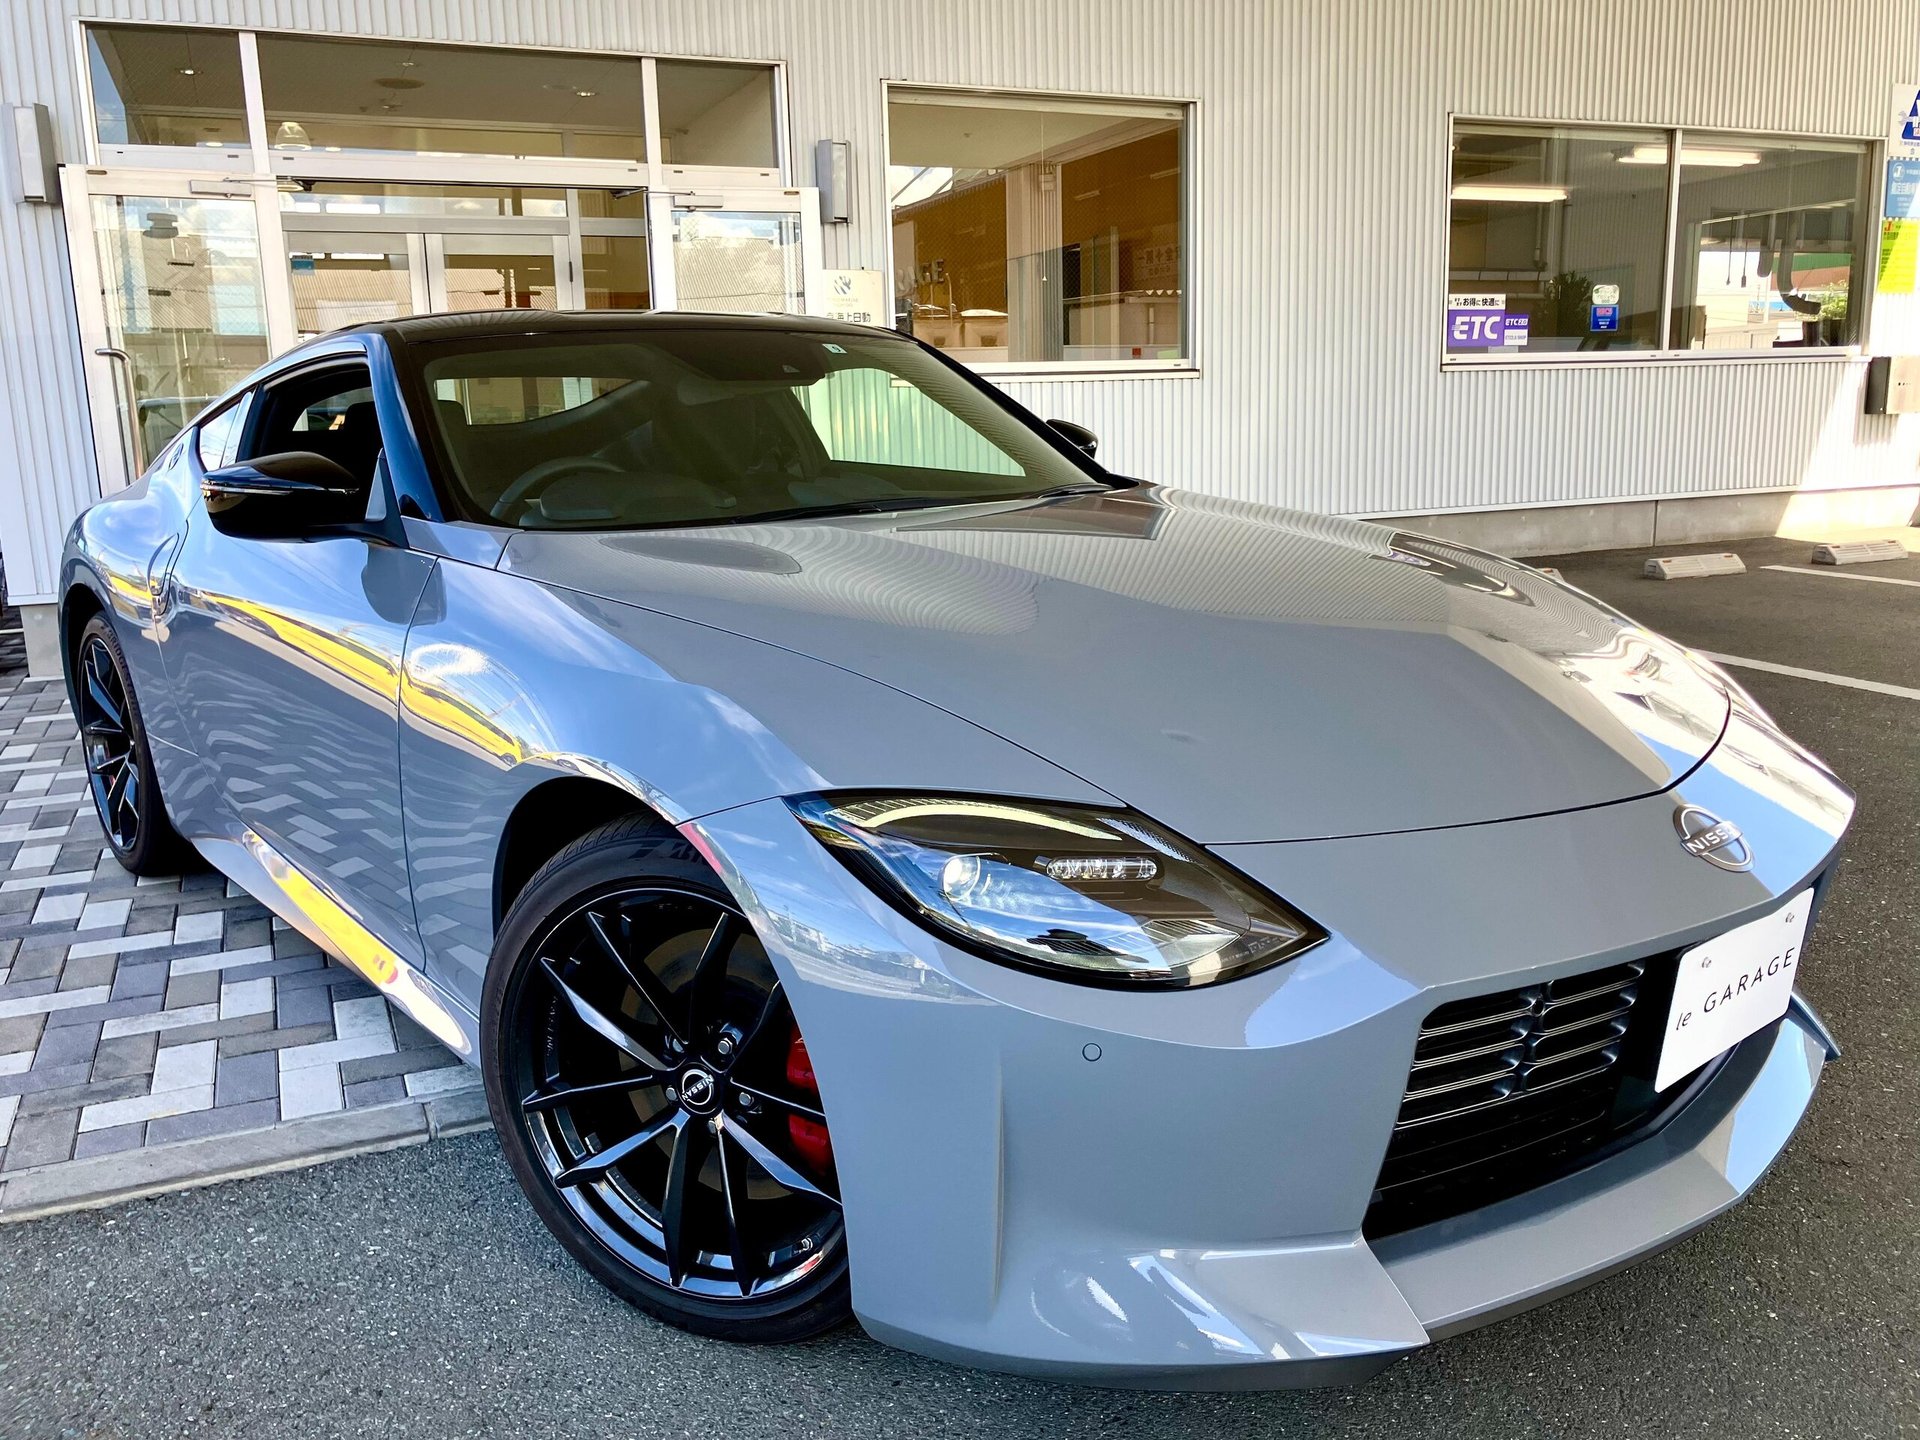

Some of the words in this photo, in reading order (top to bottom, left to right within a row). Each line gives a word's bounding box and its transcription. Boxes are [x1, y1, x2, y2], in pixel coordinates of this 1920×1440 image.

[1453, 316, 1501, 340] ETC
[1675, 1011, 1692, 1031] le
[1703, 947, 1795, 1014] GARAGE
[682, 1074, 715, 1101] NISSAN
